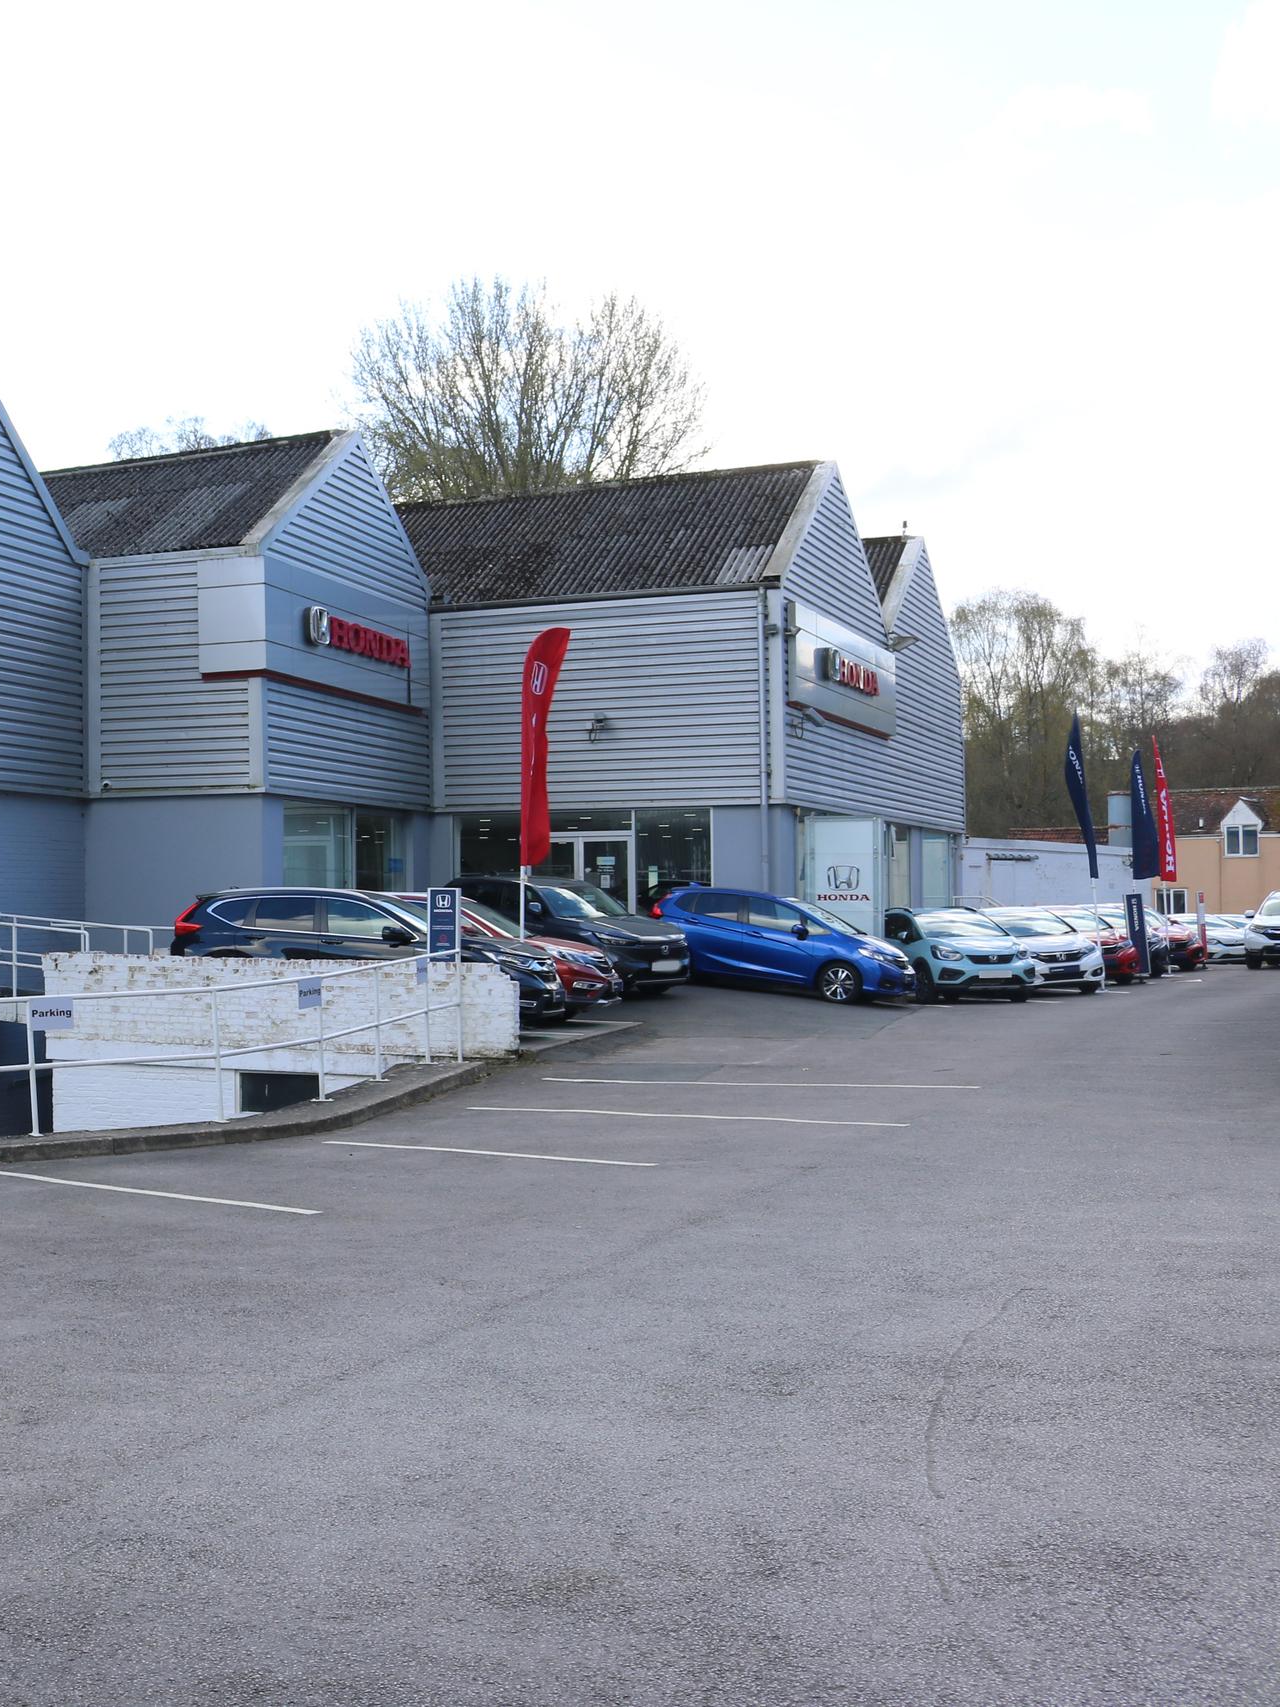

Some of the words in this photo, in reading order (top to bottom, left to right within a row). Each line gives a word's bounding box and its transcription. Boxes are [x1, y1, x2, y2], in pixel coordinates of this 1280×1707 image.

[329, 616, 411, 669] HONDA
[840, 656, 880, 697] HONDA
[299, 987, 321, 998] Parking
[31, 1008, 72, 1018] Parking
